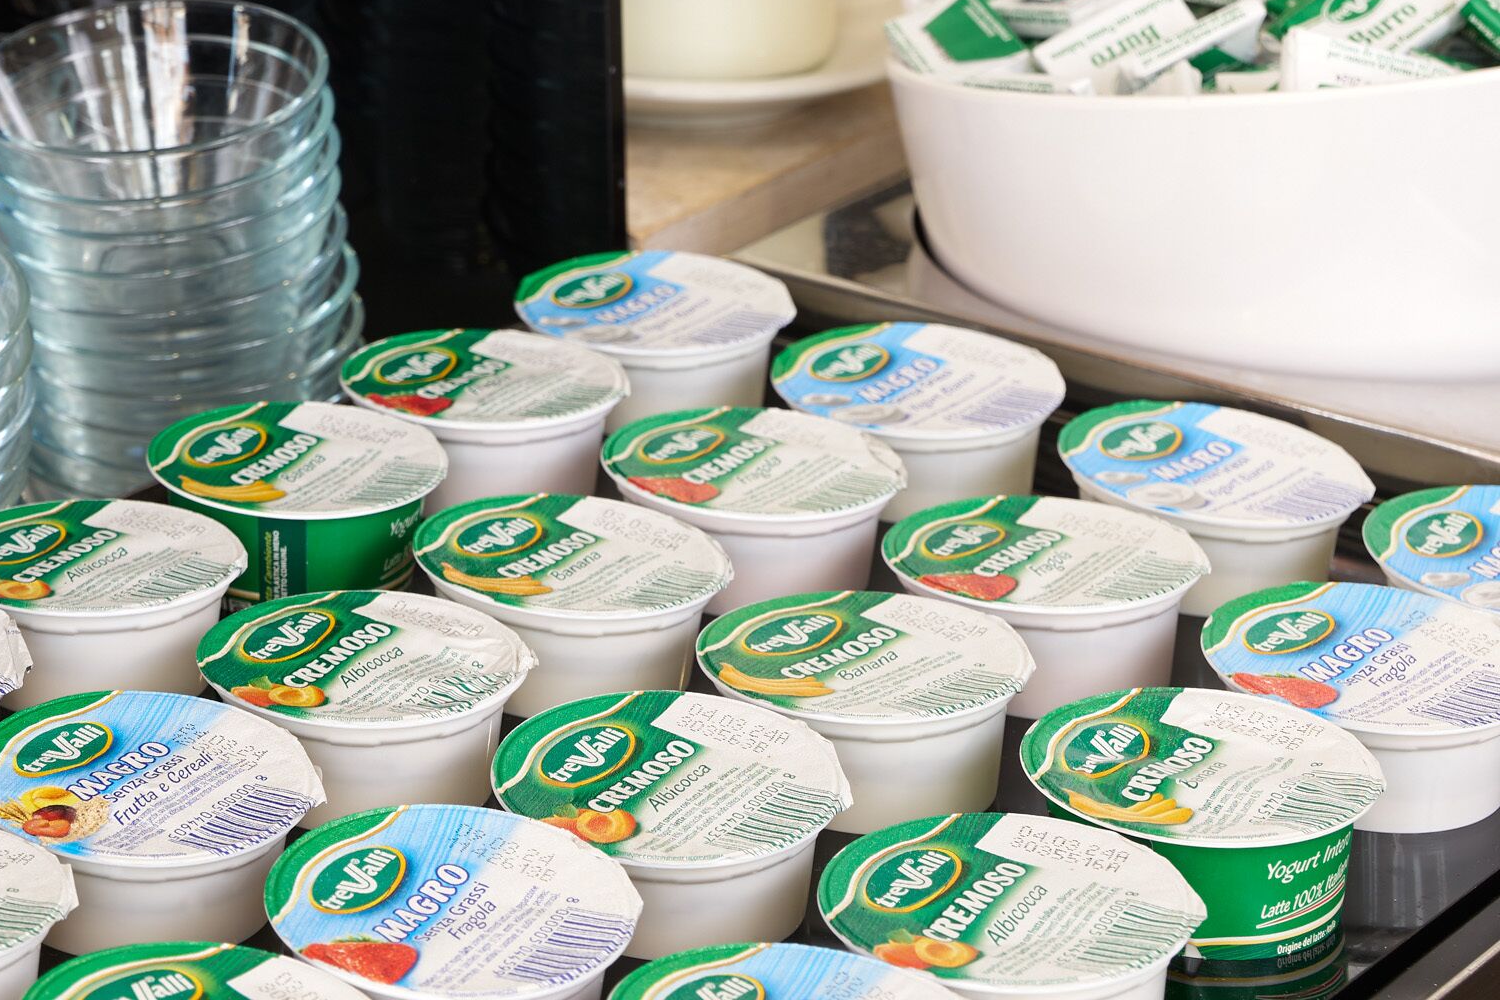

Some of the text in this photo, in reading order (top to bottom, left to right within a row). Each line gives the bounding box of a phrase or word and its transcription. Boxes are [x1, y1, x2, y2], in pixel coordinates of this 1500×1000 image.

[1091, 25, 1161, 68] Burro
[230, 433, 319, 486] CREMOSO
[1151, 440, 1233, 481] MAGRO
[12, 529, 118, 585] CREMOSO
[67, 545, 129, 583] Albicocca
[496, 531, 598, 580] CREMOSO
[550, 550, 602, 582] Banana
[972, 529, 1064, 578] CREMOSO
[282, 621, 392, 690] CREMOSO
[340, 645, 405, 690] Albicocca
[780, 625, 899, 682] CREMOSO
[835, 649, 900, 682] Banana
[1298, 627, 1395, 684] MAGRO
[1336, 641, 1412, 687] Senza Grassi
[1371, 652, 1417, 688] Fragola
[67, 740, 170, 802] MAGRO
[101, 754, 187, 805] Senza Grassi
[113, 791, 159, 826] Frutta
[170, 749, 212, 788] Cereali
[587, 738, 696, 814] CREMOSO
[648, 762, 711, 813] Albicocca
[1175, 760, 1227, 791] Banana
[214, 784, 256, 815] 000005
[743, 780, 785, 813] 000005
[1267, 851, 1321, 884] Yogurt
[375, 863, 470, 944] MAGRO
[413, 880, 491, 943] Senza Grassi
[450, 899, 496, 942] Fragola
[921, 862, 1028, 943] CREMOSO
[982, 883, 1048, 948] Albicocca
[1260, 880, 1325, 919] Latte 100%
[531, 906, 570, 945] 000005
[1277, 940, 1302, 955] Origine
[1302, 935, 1312, 947] del
